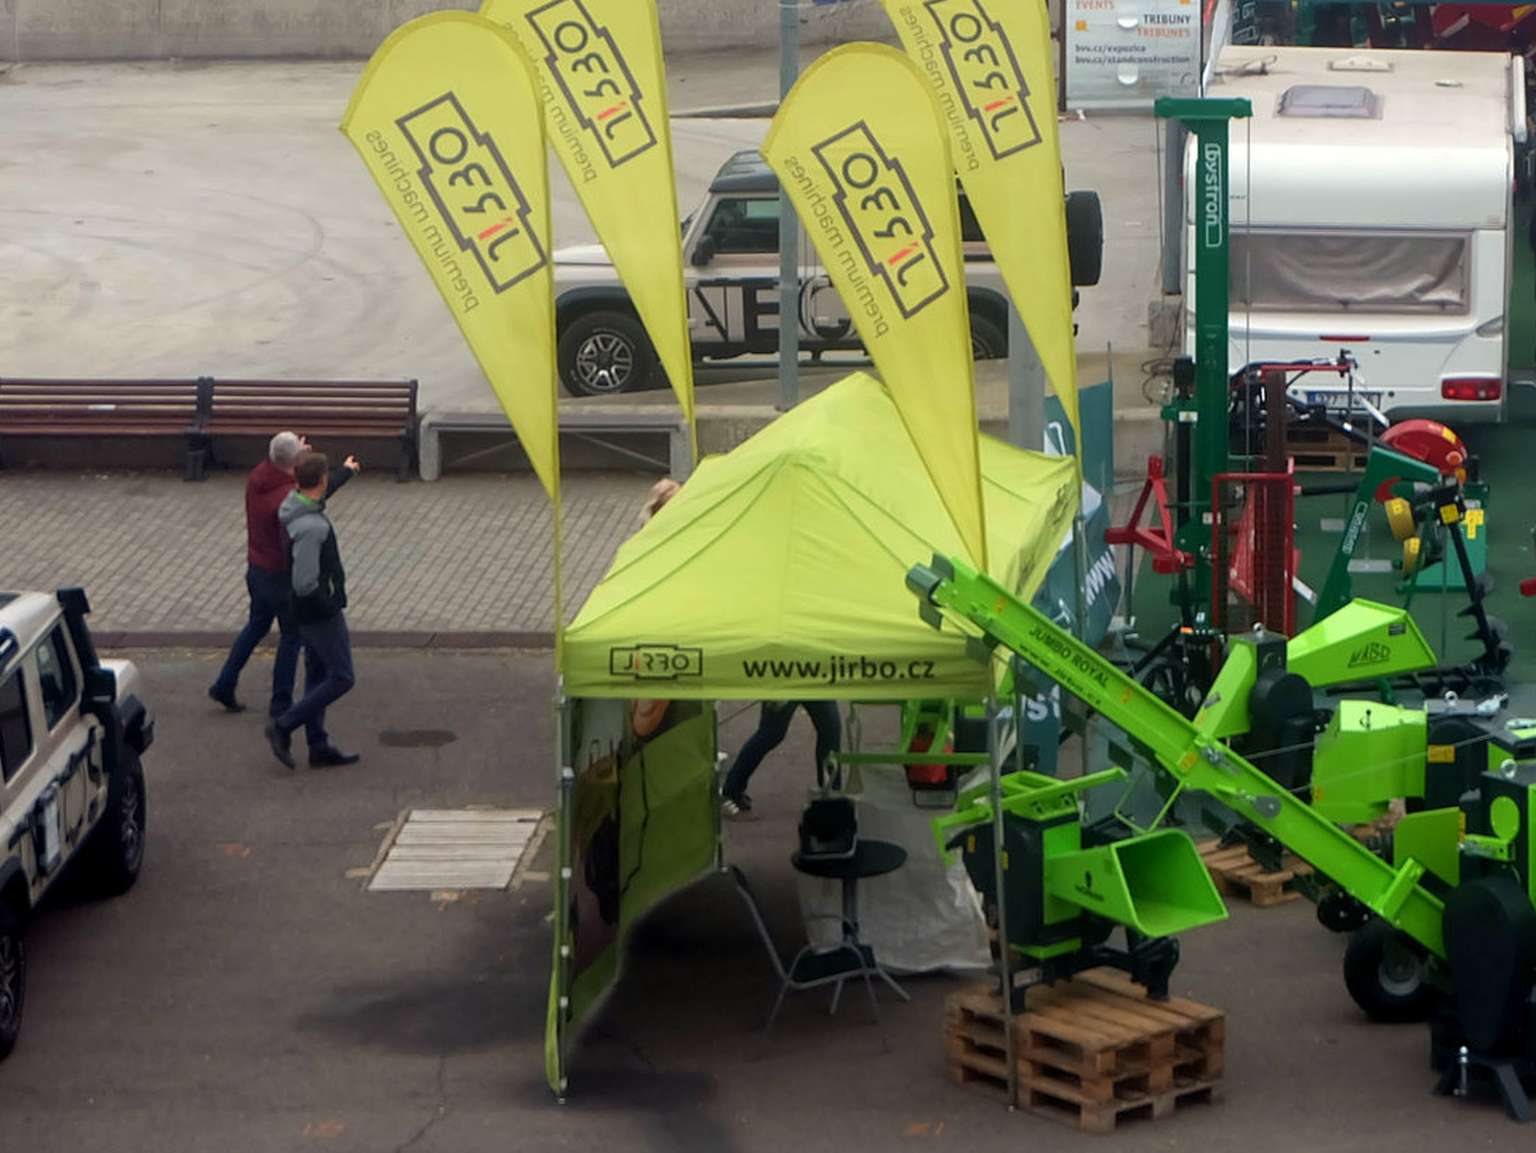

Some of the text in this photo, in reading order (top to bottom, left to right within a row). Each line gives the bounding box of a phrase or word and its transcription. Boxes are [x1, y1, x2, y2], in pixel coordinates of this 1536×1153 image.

[1143, 14, 1192, 24] TRIBUNY
[1136, 27, 1192, 38] TRIBUNES
[742, 655, 936, 686] www.jirbo.cz
